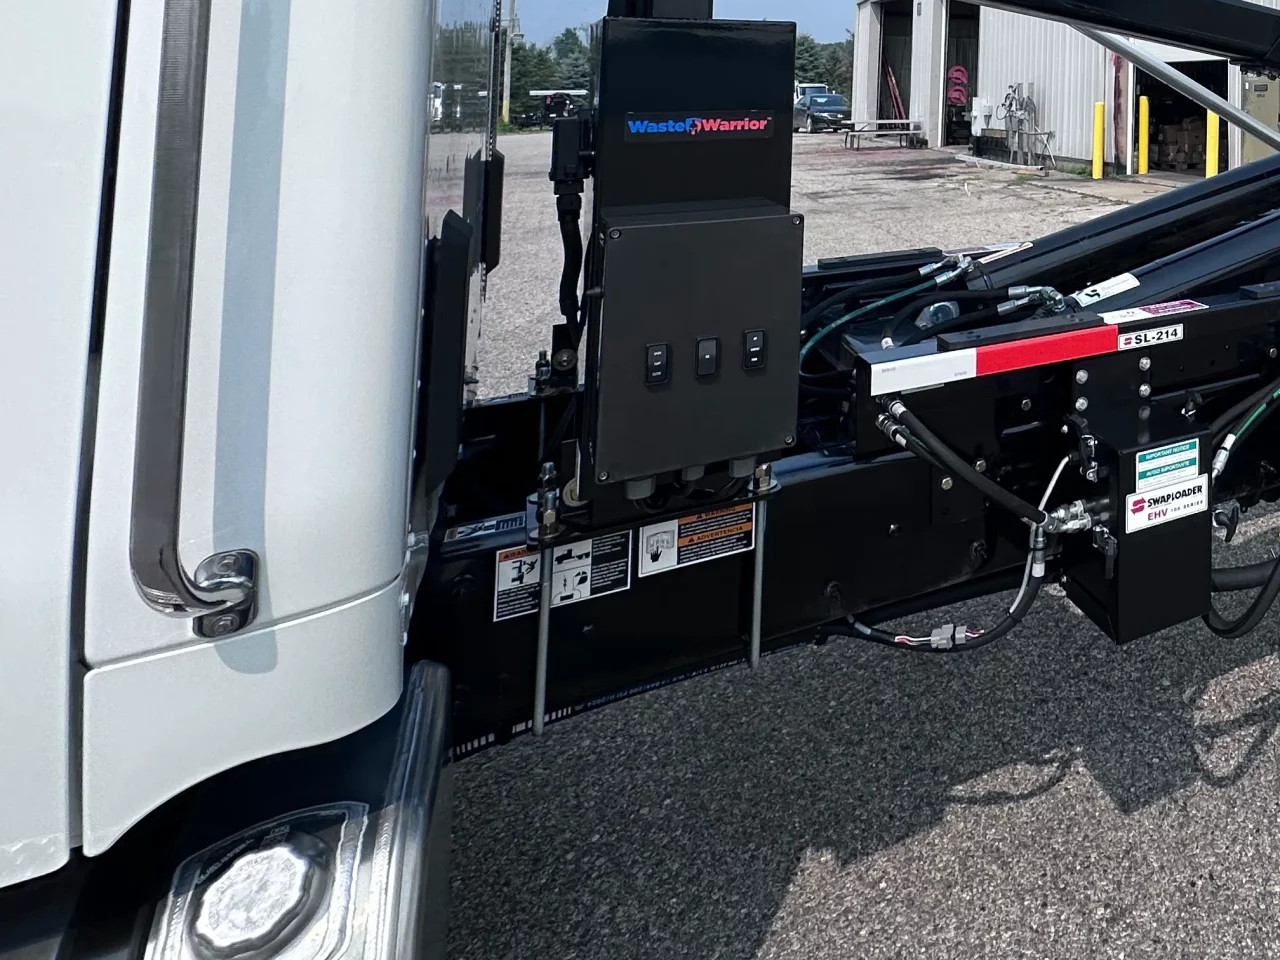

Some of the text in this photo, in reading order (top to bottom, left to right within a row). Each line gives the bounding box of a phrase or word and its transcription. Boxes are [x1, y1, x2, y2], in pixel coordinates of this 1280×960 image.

[627, 117, 768, 133] Waste Warrior
[1134, 328, 1178, 345] SL-214
[1147, 485, 1202, 507] SWAPLOADER
[1148, 508, 1168, 521] EHV
[696, 527, 744, 541] ADVERTENCIA
